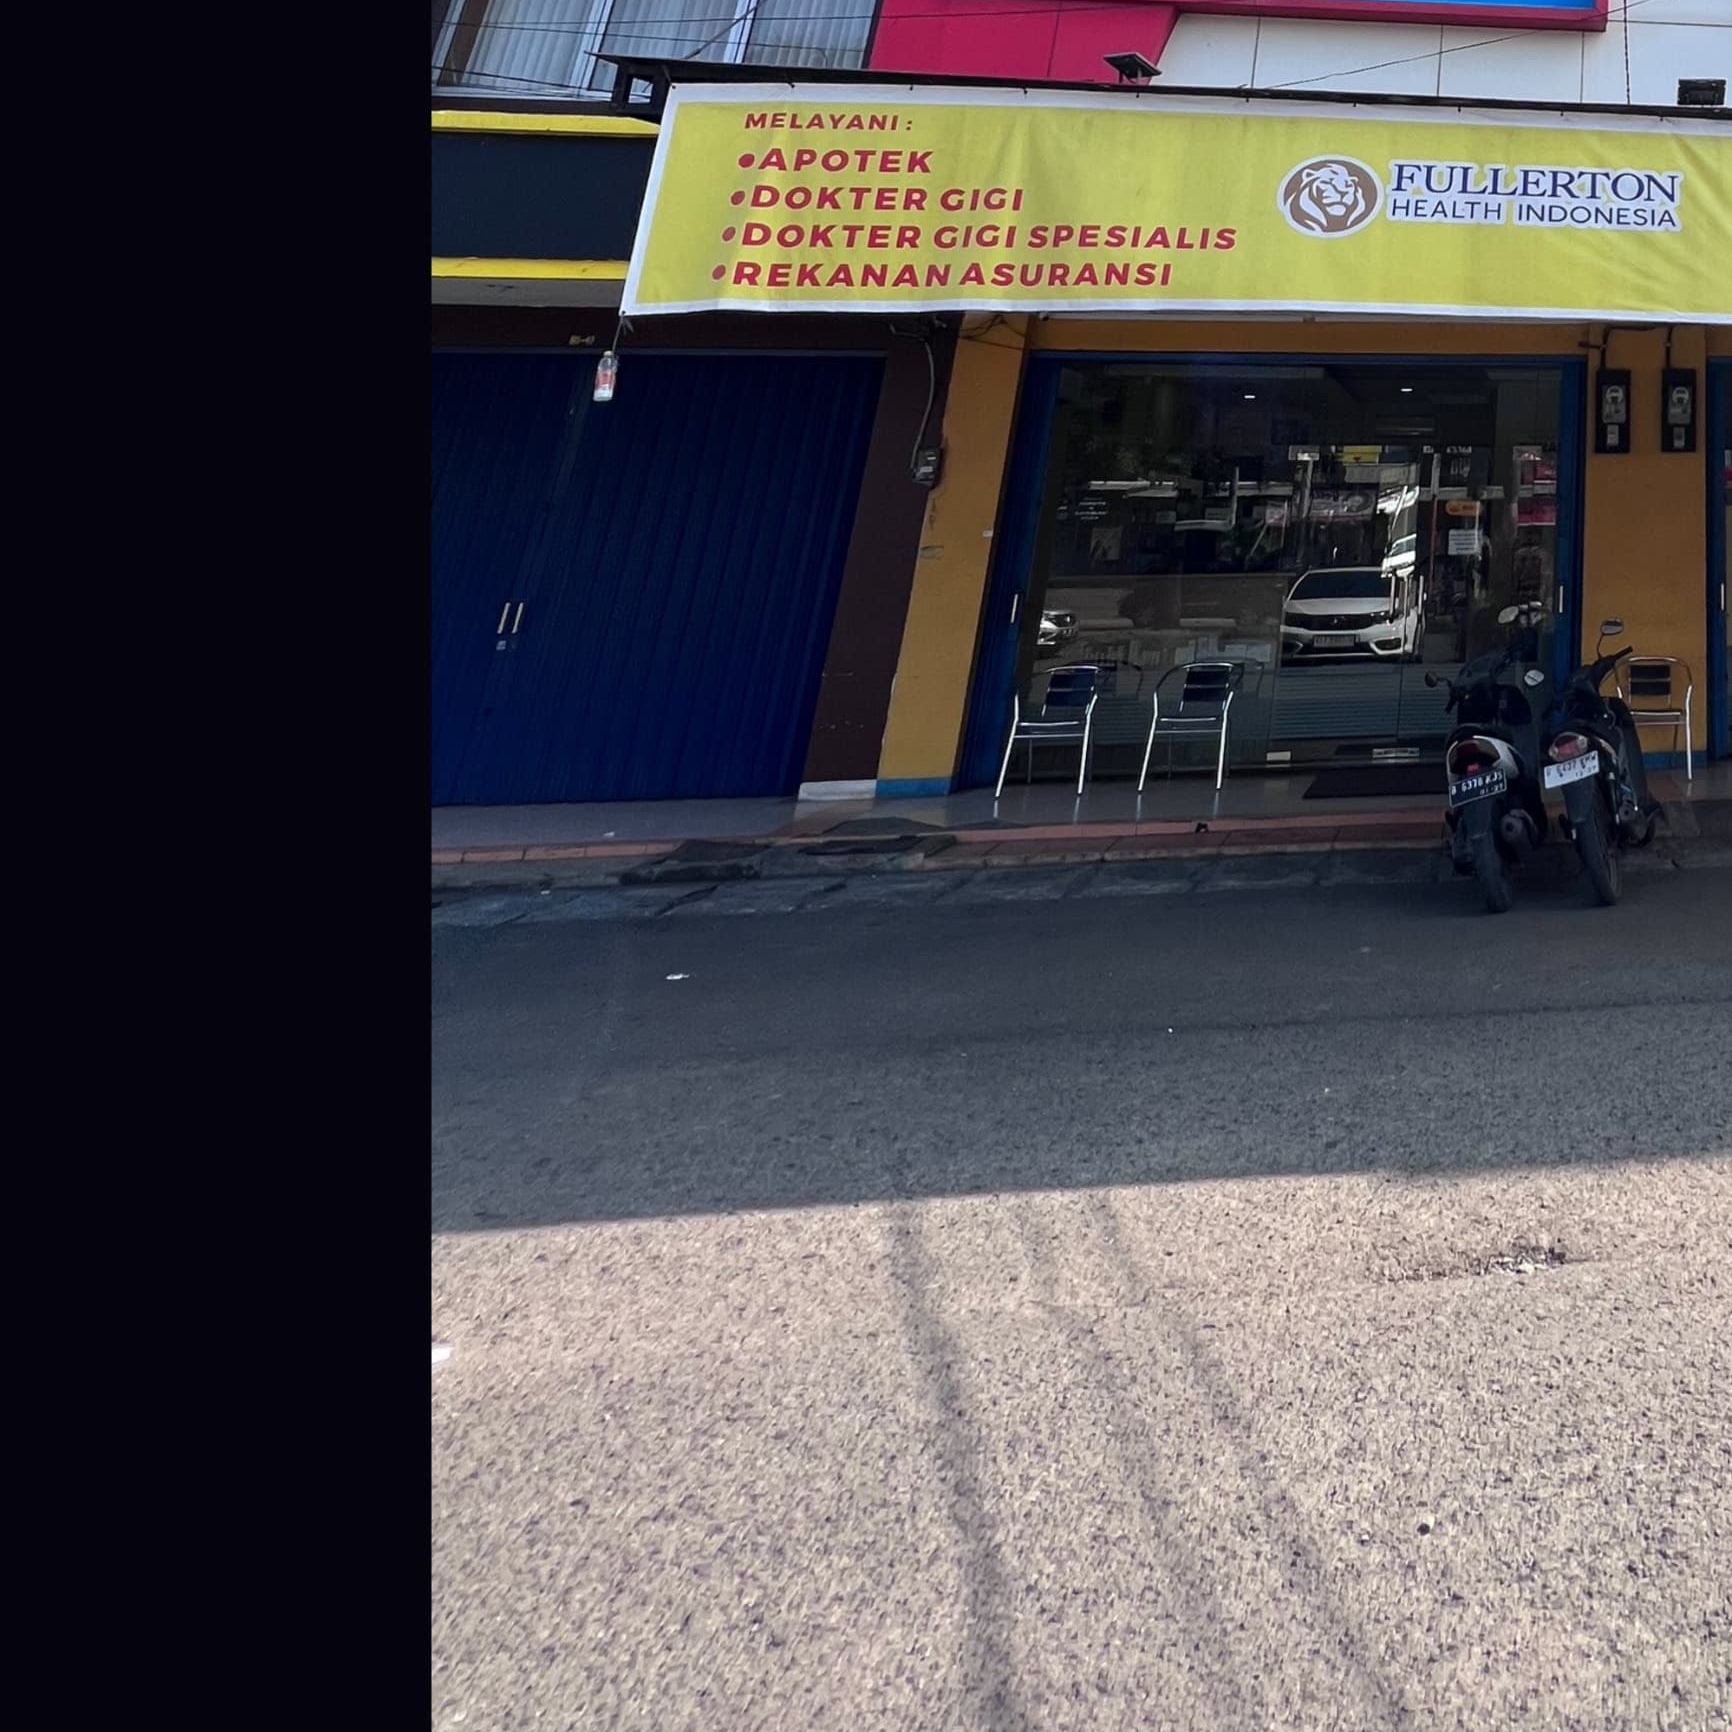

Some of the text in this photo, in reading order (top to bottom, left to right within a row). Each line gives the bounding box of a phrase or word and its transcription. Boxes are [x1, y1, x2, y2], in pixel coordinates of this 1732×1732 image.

[745, 112, 899, 130] MELAYANI
[757, 147, 934, 173] APOTEK
[1391, 163, 1678, 203] FULLERTON
[749, 184, 1025, 212] DOKTER GIGI
[1392, 198, 1677, 228] HEALTH INDONESIA
[741, 222, 1239, 251] DOKTER GIGI SPESIALIS
[732, 262, 1173, 288] REKANAN ASURANSI
